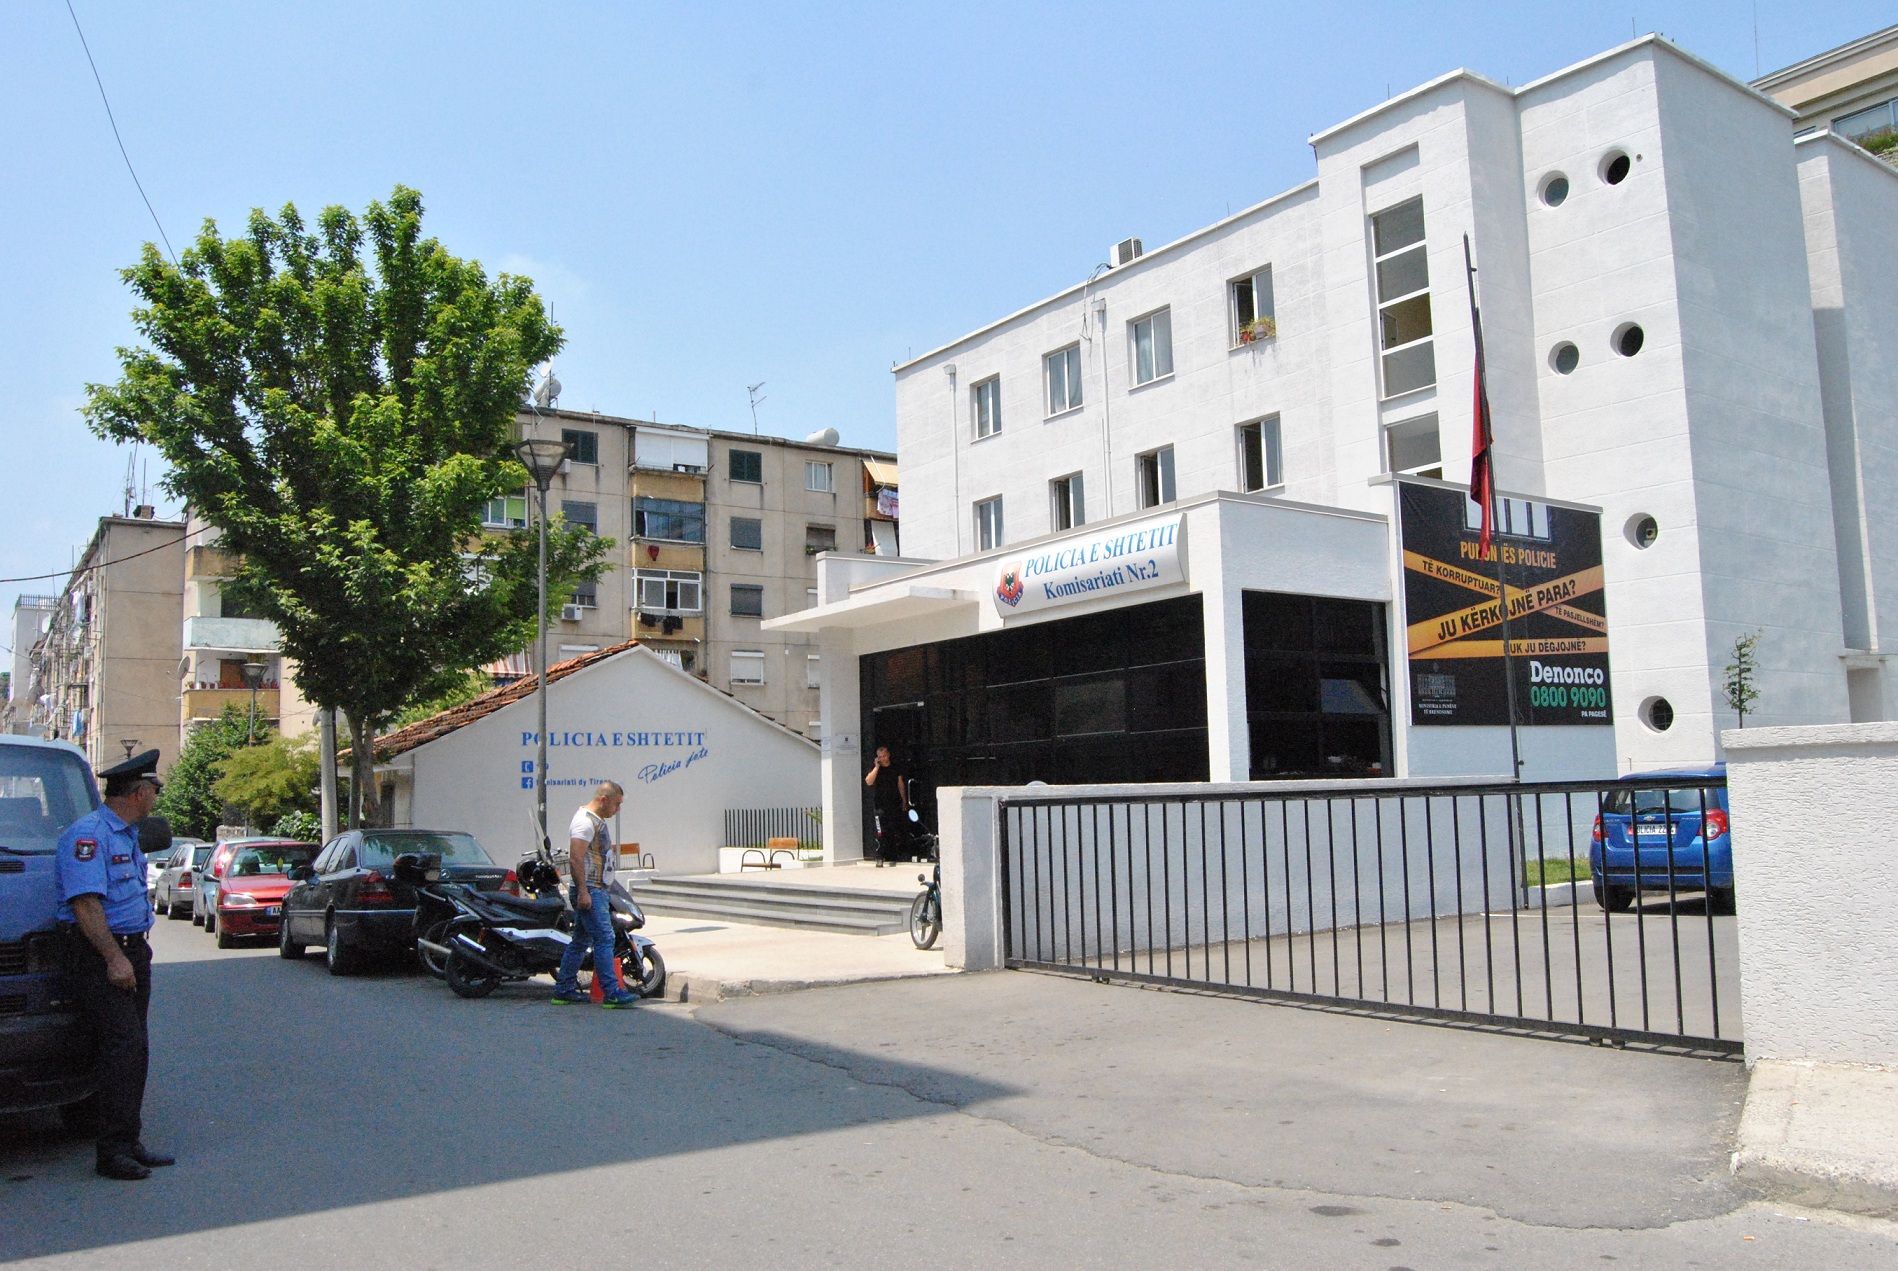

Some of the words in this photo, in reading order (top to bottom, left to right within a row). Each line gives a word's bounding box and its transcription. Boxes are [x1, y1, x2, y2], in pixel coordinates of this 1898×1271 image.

[1025, 551, 1085, 578] POLICIA
[1089, 542, 1101, 563] E
[1103, 523, 1179, 560] SHTETIT
[1518, 549, 1557, 569] POLICIE
[1043, 566, 1126, 600] Komisariati
[1126, 559, 1159, 584] Nr.2
[1422, 560, 1434, 572] TË
[1436, 565, 1501, 594] KORRUPTUAR?
[1437, 621, 1457, 641] JU
[1537, 579, 1576, 607] PARA?
[1505, 643, 1523, 654] UK
[1525, 642, 1536, 653] JU
[1530, 660, 1604, 685] Denonco
[1530, 686, 1568, 707] 0800
[1570, 686, 1607, 708] 9090
[612, 732, 623, 746] E
[626, 731, 705, 746] SHTETIT
[637, 760, 682, 784] Policia
[1636, 825, 1655, 834] OLICIA
